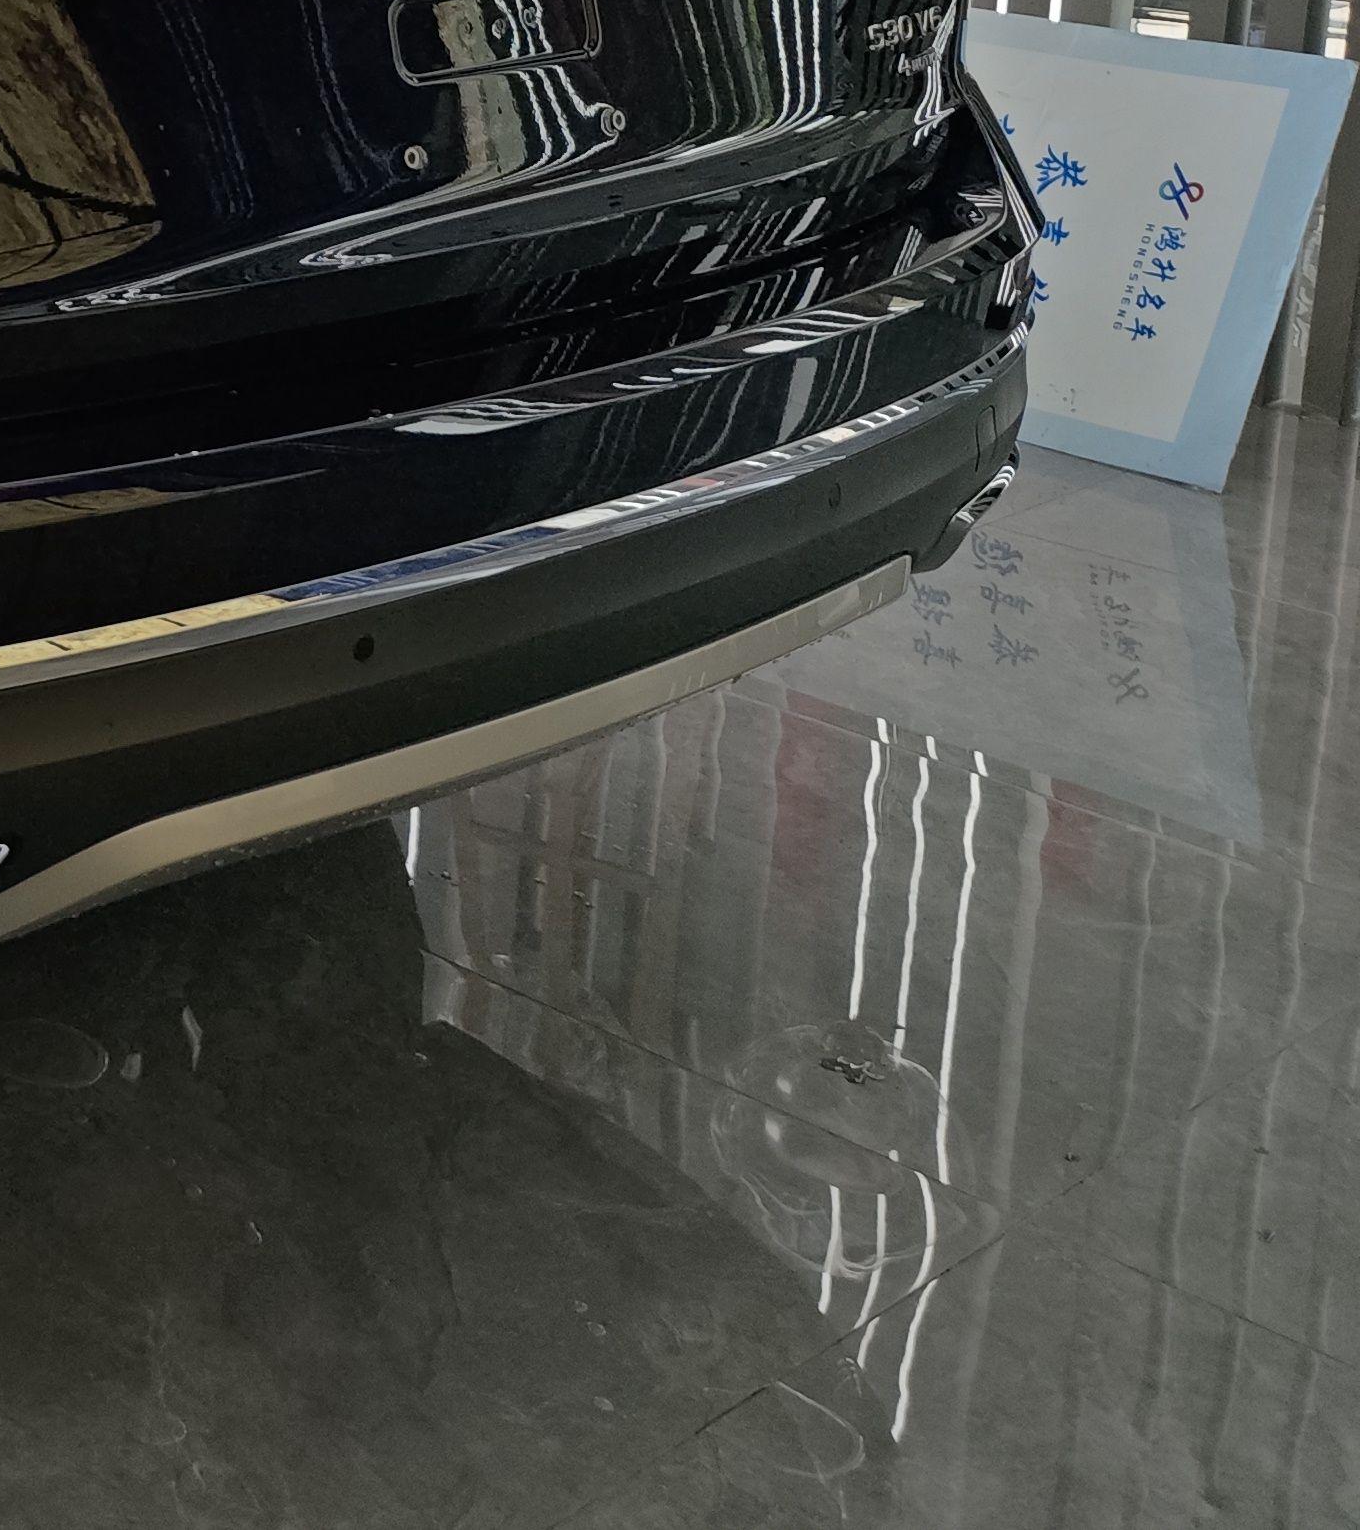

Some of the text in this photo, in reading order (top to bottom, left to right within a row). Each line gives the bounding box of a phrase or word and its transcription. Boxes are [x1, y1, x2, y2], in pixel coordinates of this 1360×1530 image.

[867, 5, 944, 51] 530 V6
[1112, 222, 1156, 331] HONGSHENG
[1123, 225, 1187, 342] 鸿升名车
